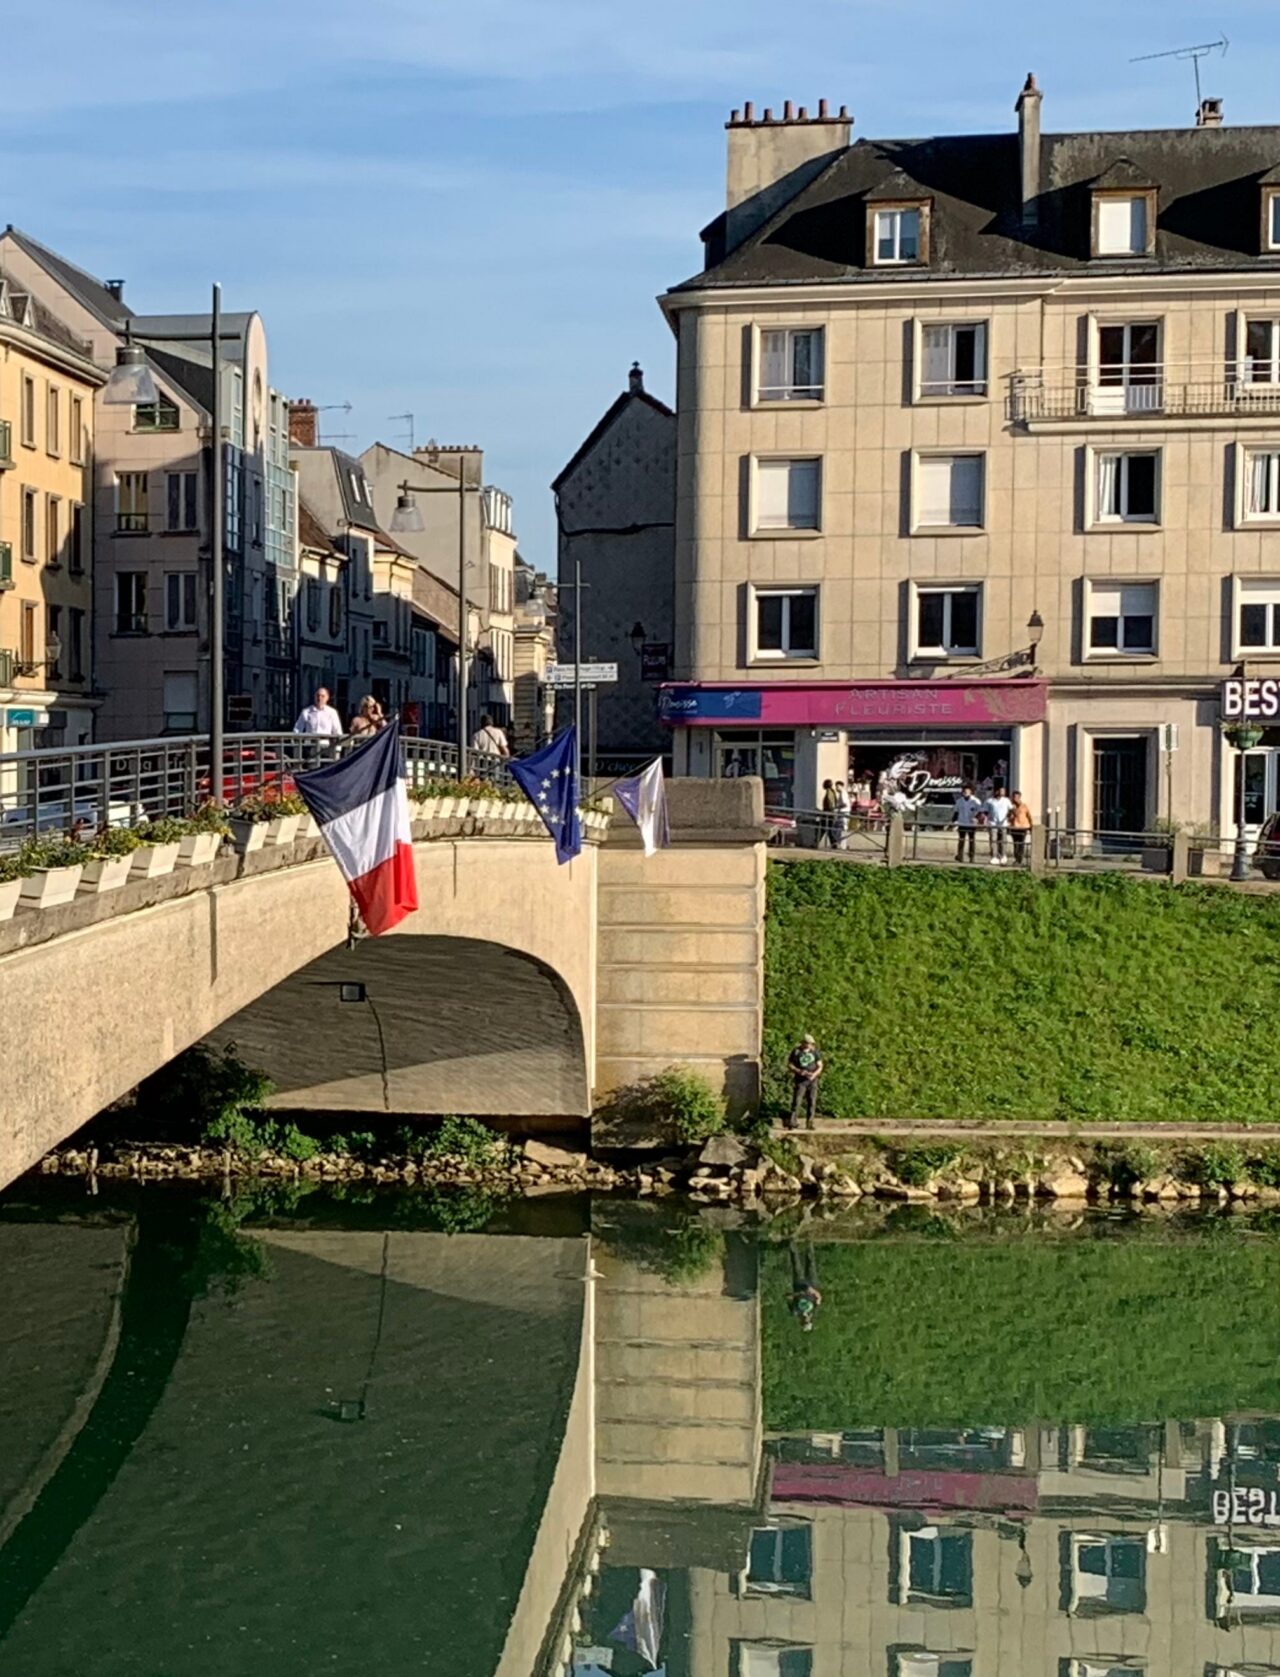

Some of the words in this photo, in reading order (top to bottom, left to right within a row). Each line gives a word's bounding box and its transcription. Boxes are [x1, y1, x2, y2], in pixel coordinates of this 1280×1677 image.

[848, 688, 938, 700] ARTISAN
[1225, 681, 1280, 716] BES
[834, 703, 952, 716] FLEURISTE
